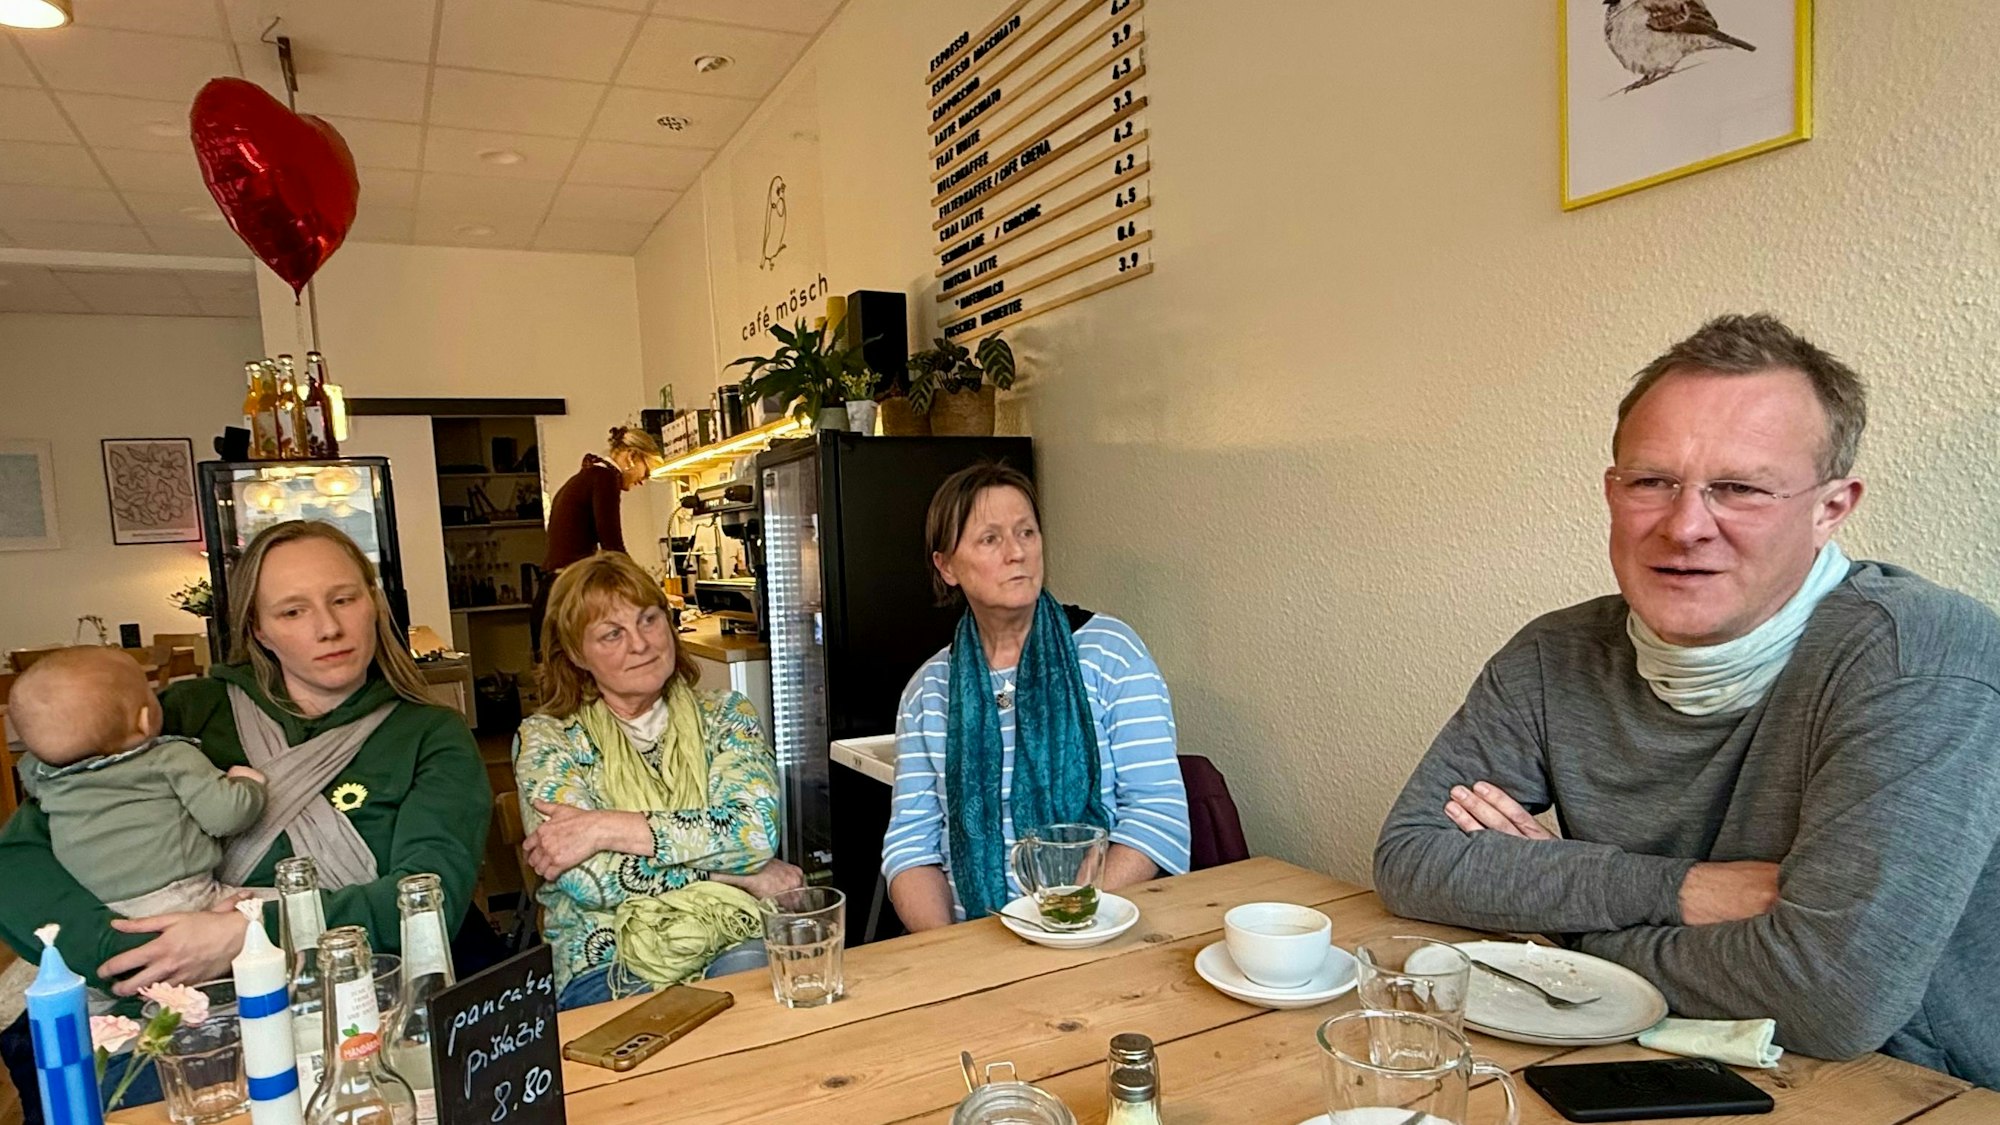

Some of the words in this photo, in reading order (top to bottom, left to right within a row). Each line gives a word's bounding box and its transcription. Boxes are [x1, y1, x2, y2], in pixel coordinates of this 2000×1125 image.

[930, 31, 969, 73] ESPRESSO
[932, 57, 970, 97] ESPRESSO
[973, 15, 1021, 63] MACCHIATO
[932, 76, 980, 122] CAPPUCCINO
[935, 121, 957, 147] LATTE
[958, 88, 1002, 129] MACCHIATO
[936, 148, 954, 170] FLAT
[956, 129, 981, 156] WHITE
[1112, 24, 1131, 48] 3.9
[937, 151, 989, 195] MILCHKAFFEE
[1112, 58, 1131, 80] 4.3
[939, 176, 993, 219] FILTERKAFFEE
[1020, 139, 1052, 168] CREMA
[1113, 90, 1132, 113] 3.3
[940, 222, 959, 242] CHAI
[961, 206, 984, 231] LATTE
[1114, 121, 1133, 143] 4.2
[1115, 153, 1134, 175] 4.2
[943, 268, 972, 292] MATCHA
[974, 254, 998, 277] LATTE
[1116, 186, 1136, 208] 4.5
[1119, 252, 1139, 272] 3.9
[742, 305, 770, 341] café
[776, 272, 829, 321] mösch
[448, 969, 553, 1057] pancakes
[491, 1066, 552, 1122] 8.80
